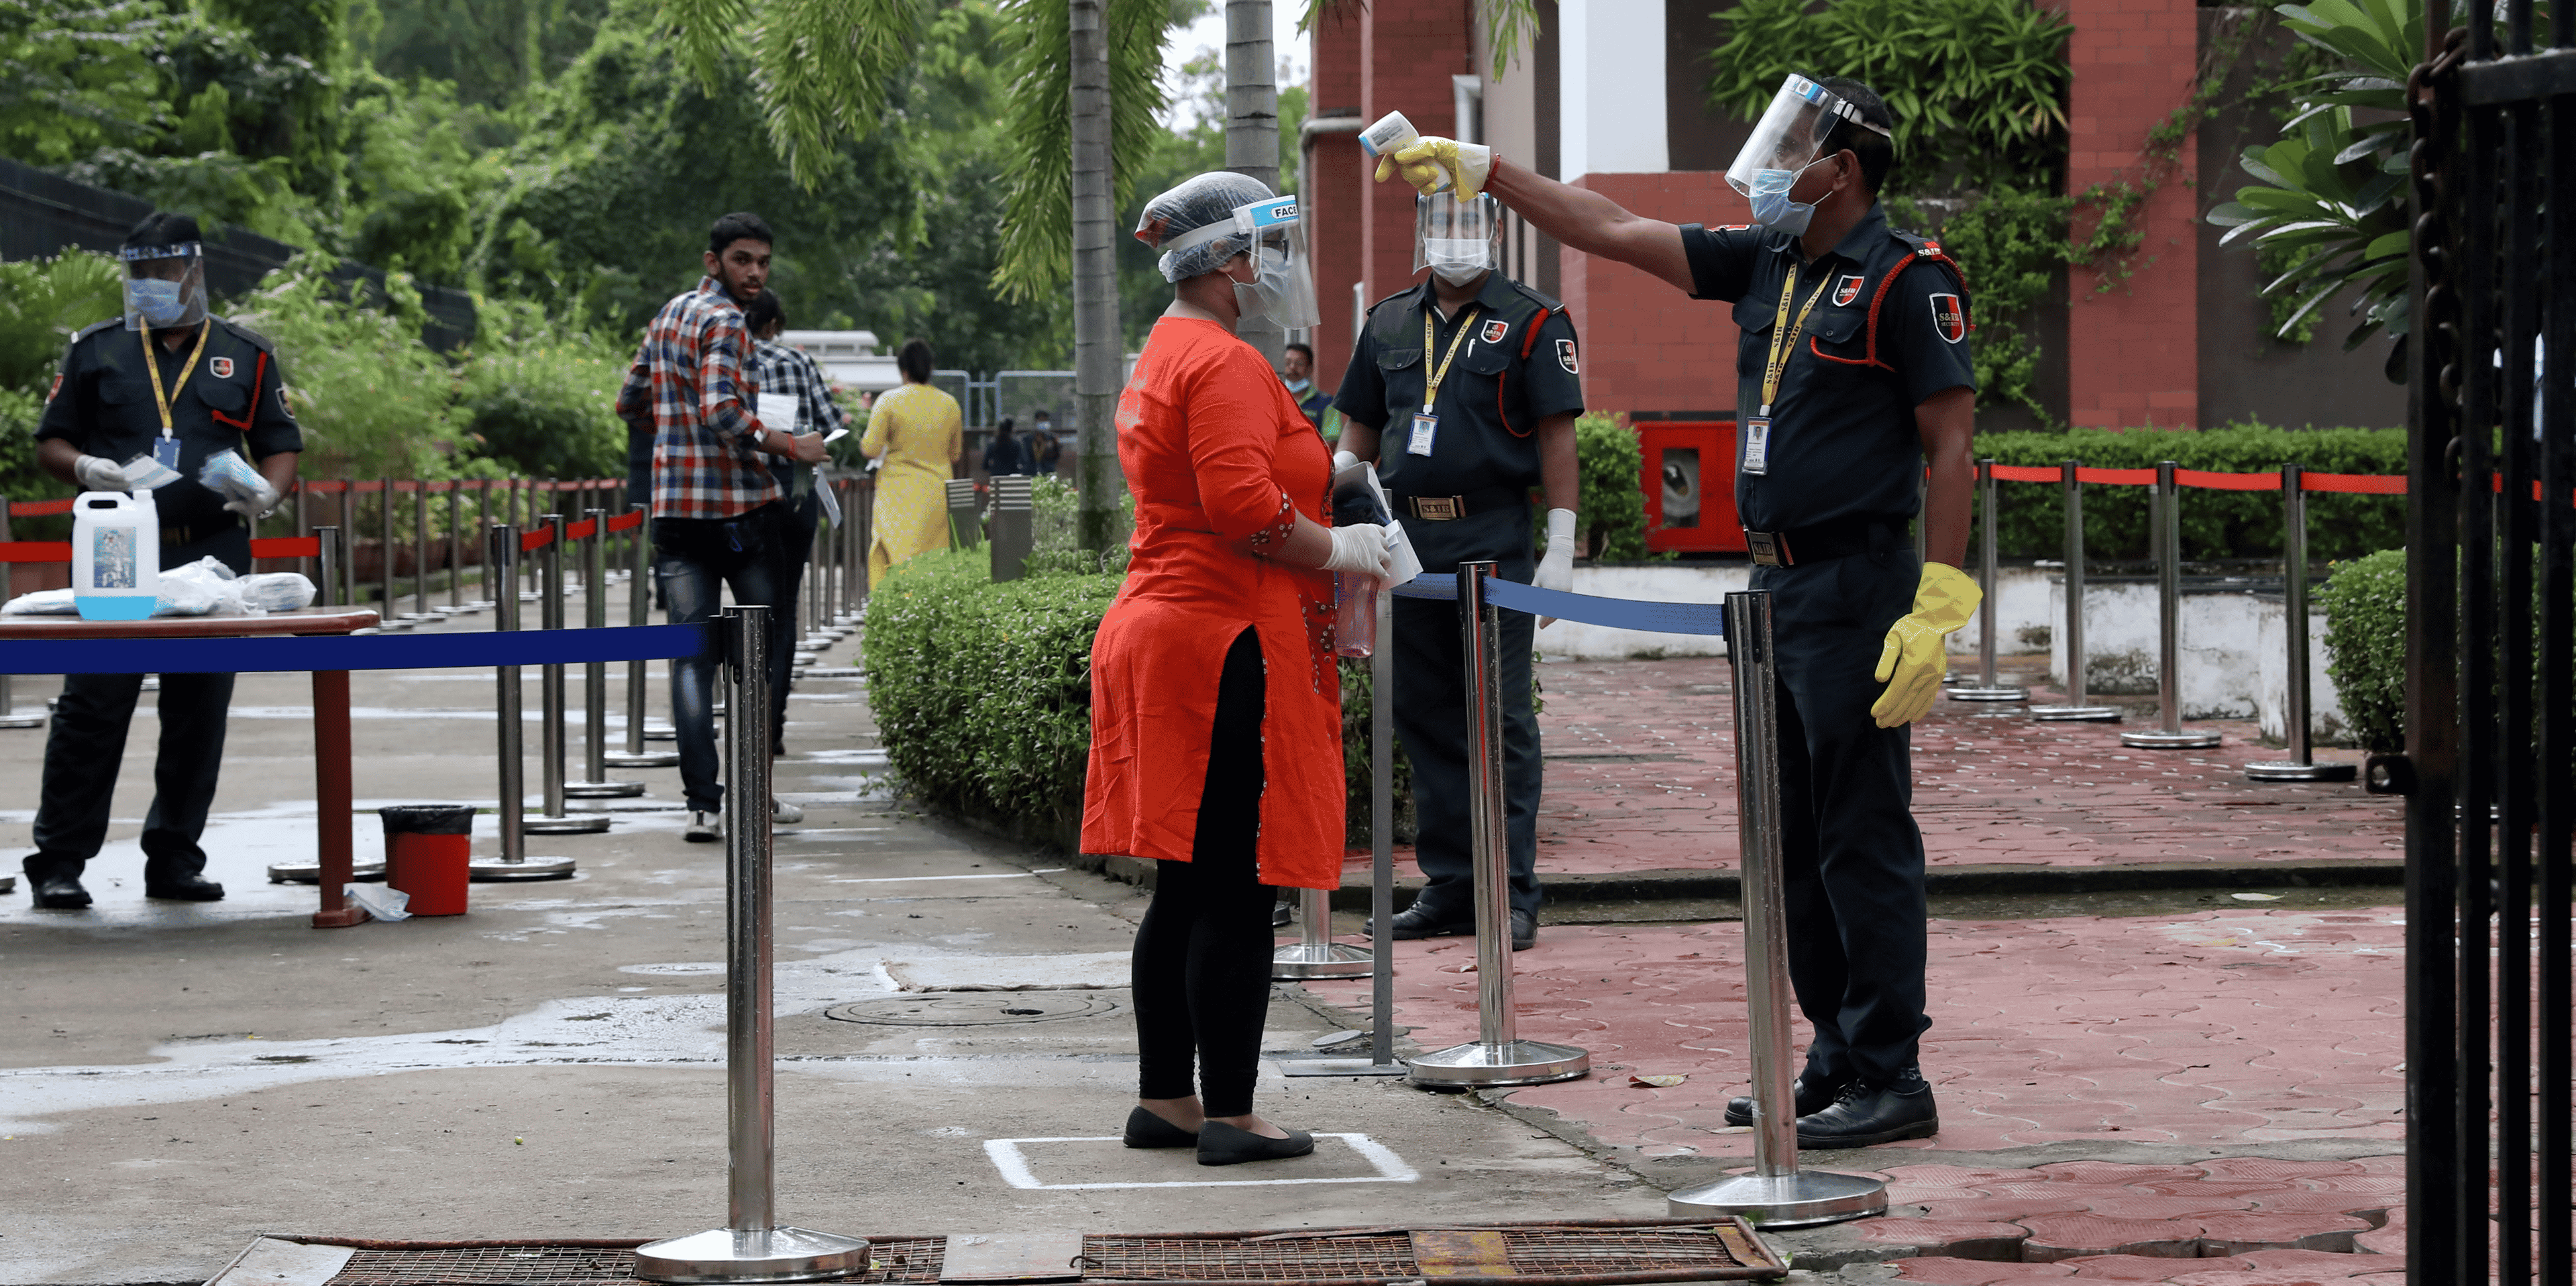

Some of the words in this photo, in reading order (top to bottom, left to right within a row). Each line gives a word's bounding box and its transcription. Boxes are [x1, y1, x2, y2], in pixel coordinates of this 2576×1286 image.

[1275, 206, 1297, 217] FACE
[1918, 248, 1941, 256] S&IB
[1788, 263, 1796, 279] S&I
[1780, 292, 1791, 313] S&IB
[1939, 313, 1960, 321] S&IB
[1773, 326, 1784, 348] S&IB
[1787, 325, 1801, 348] S&IB
[1444, 349, 1454, 365] S&IB
[1766, 362, 1775, 384] S&IB
[1422, 504, 1450, 513] S&IB
[1754, 543, 1772, 554] S&IB
